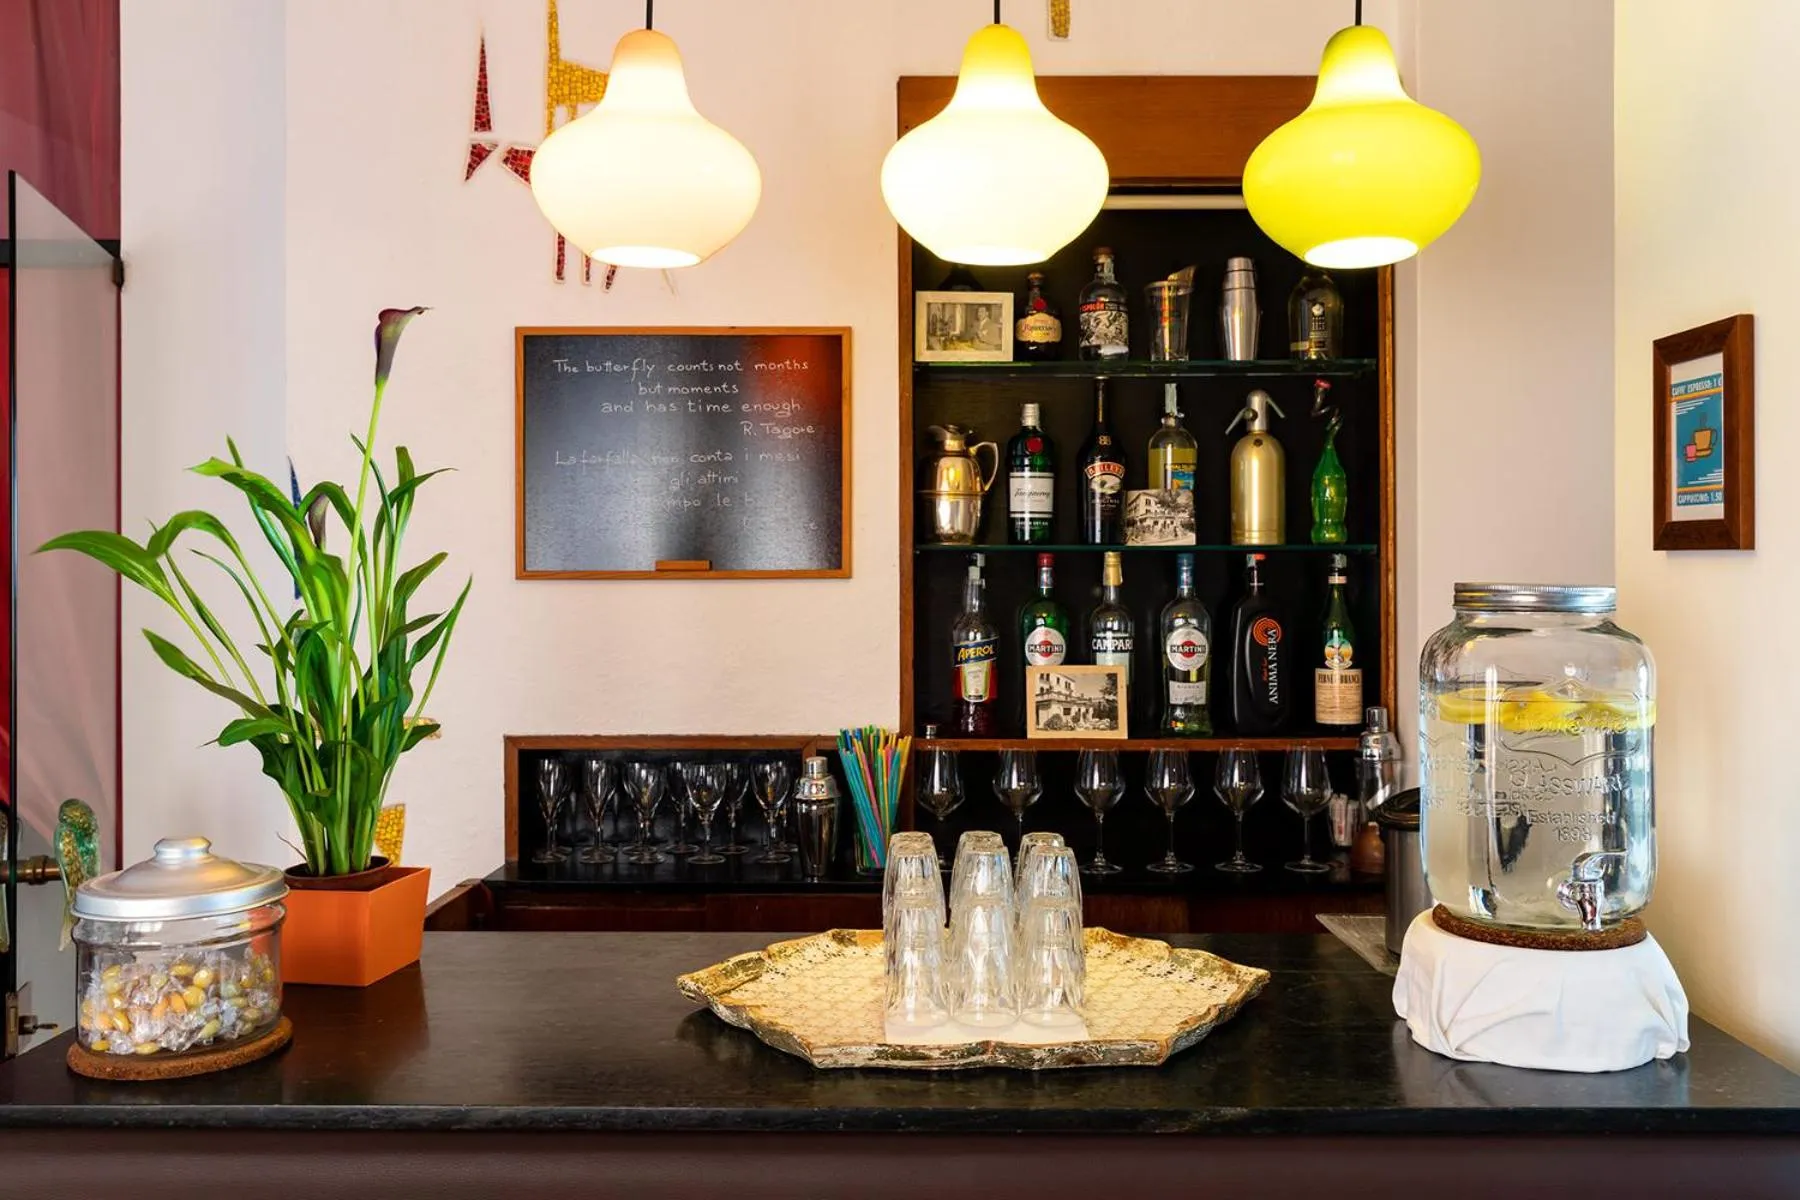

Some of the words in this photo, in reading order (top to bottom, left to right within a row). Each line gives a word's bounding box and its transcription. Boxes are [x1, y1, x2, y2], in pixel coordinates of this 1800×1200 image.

[553, 358, 579, 373] The
[585, 358, 655, 382] butterfly
[667, 359, 714, 372] counts
[718, 360, 743, 371] not
[754, 359, 809, 371] months
[638, 381, 662, 395] but
[667, 383, 739, 395] moments
[600, 400, 634, 413] and
[645, 399, 679, 413] has
[687, 400, 733, 412] time
[741, 398, 802, 418] enough
[740, 420, 757, 436] R.
[760, 422, 816, 439] Tagore
[690, 449, 734, 463] conta
[697, 470, 738, 485] attimi
[717, 492, 733, 507] le
[1028, 645, 1064, 653] MARTINI
[1091, 638, 1134, 651] CAMPARI
[1170, 645, 1206, 653] MARTINI
[1267, 628, 1277, 661] NERA
[957, 645, 995, 661] APEROL
[1268, 662, 1279, 704] ANIMA
